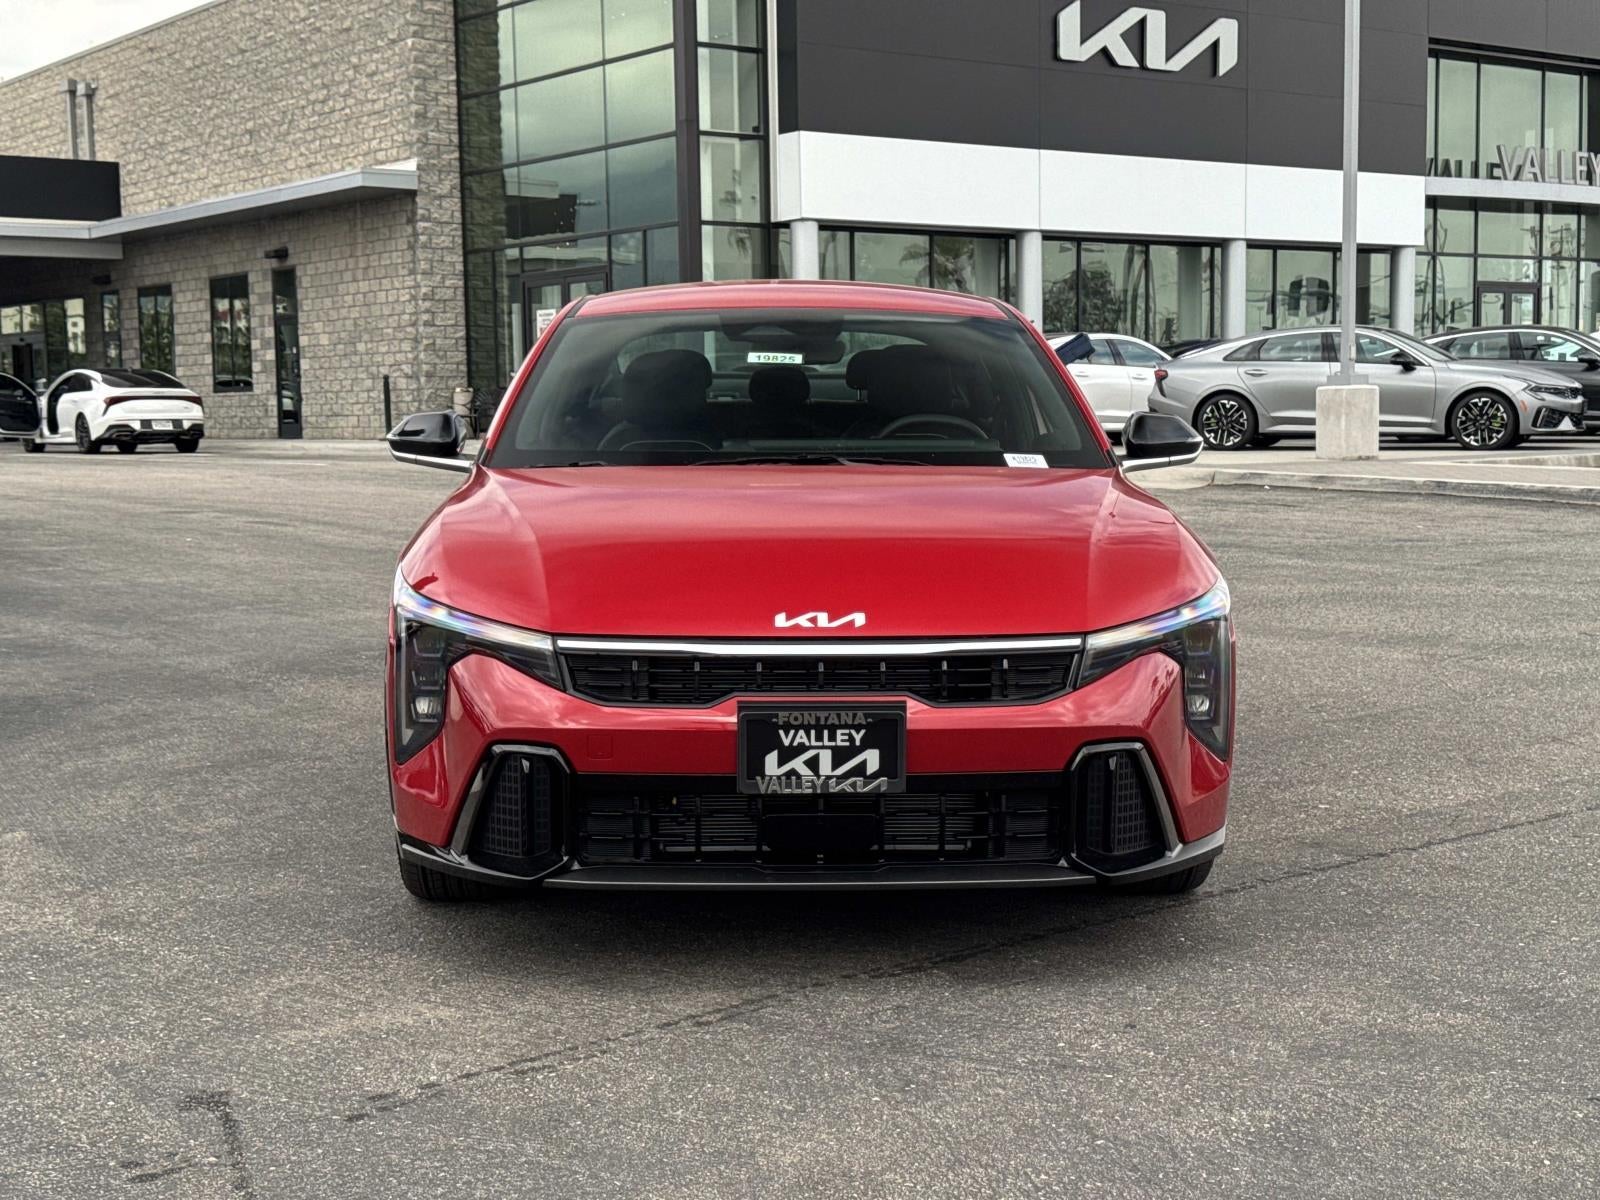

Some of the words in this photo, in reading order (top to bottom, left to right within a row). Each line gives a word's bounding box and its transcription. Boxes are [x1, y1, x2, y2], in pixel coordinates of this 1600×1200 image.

[1057, 0, 1239, 77] KIA
[756, 354, 796, 362] 19825
[775, 612, 866, 628] KIA
[778, 712, 867, 725] FONTANA
[779, 729, 866, 746] VALLEY
[765, 749, 880, 776] KIA
[756, 776, 826, 794] VALLEY
[828, 777, 888, 793] KIA
